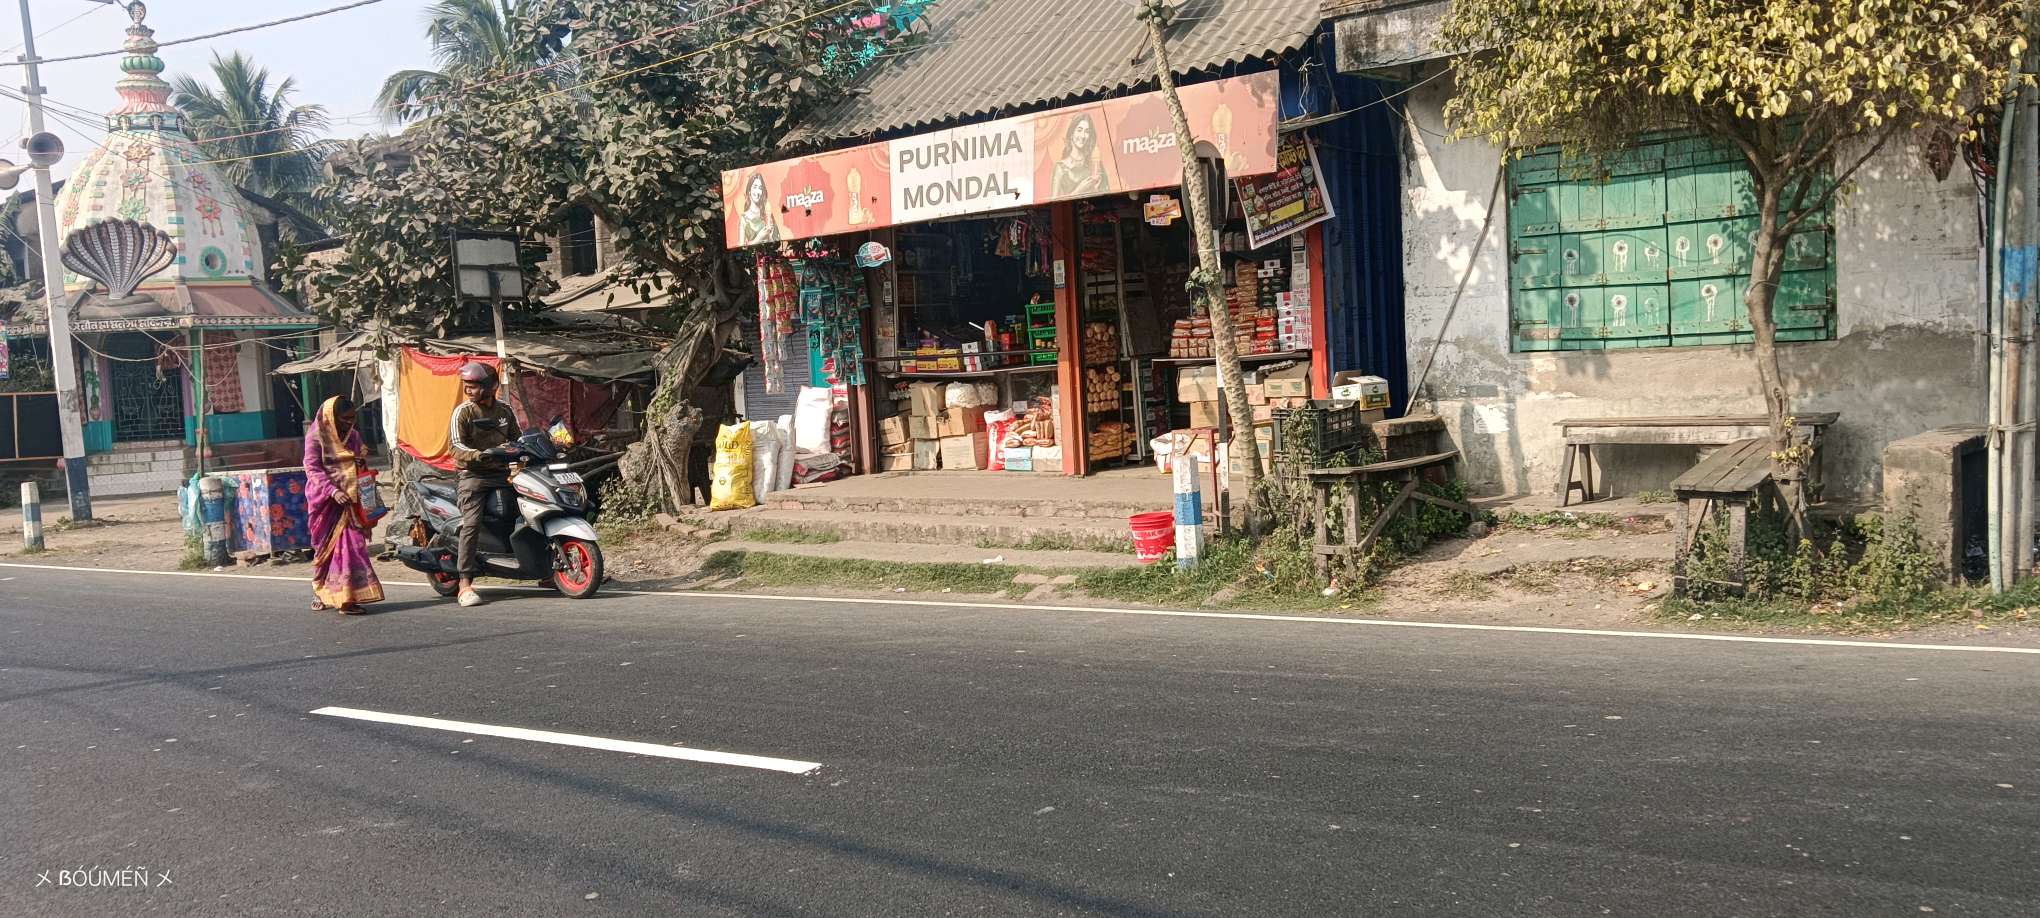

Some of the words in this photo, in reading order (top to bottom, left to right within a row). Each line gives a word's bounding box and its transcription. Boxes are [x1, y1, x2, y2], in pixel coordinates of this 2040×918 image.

[900, 131, 1022, 173] PURNIMA
[1123, 132, 1176, 154] maaza
[786, 190, 824, 208] maaza
[903, 171, 1018, 210] MONDAL
